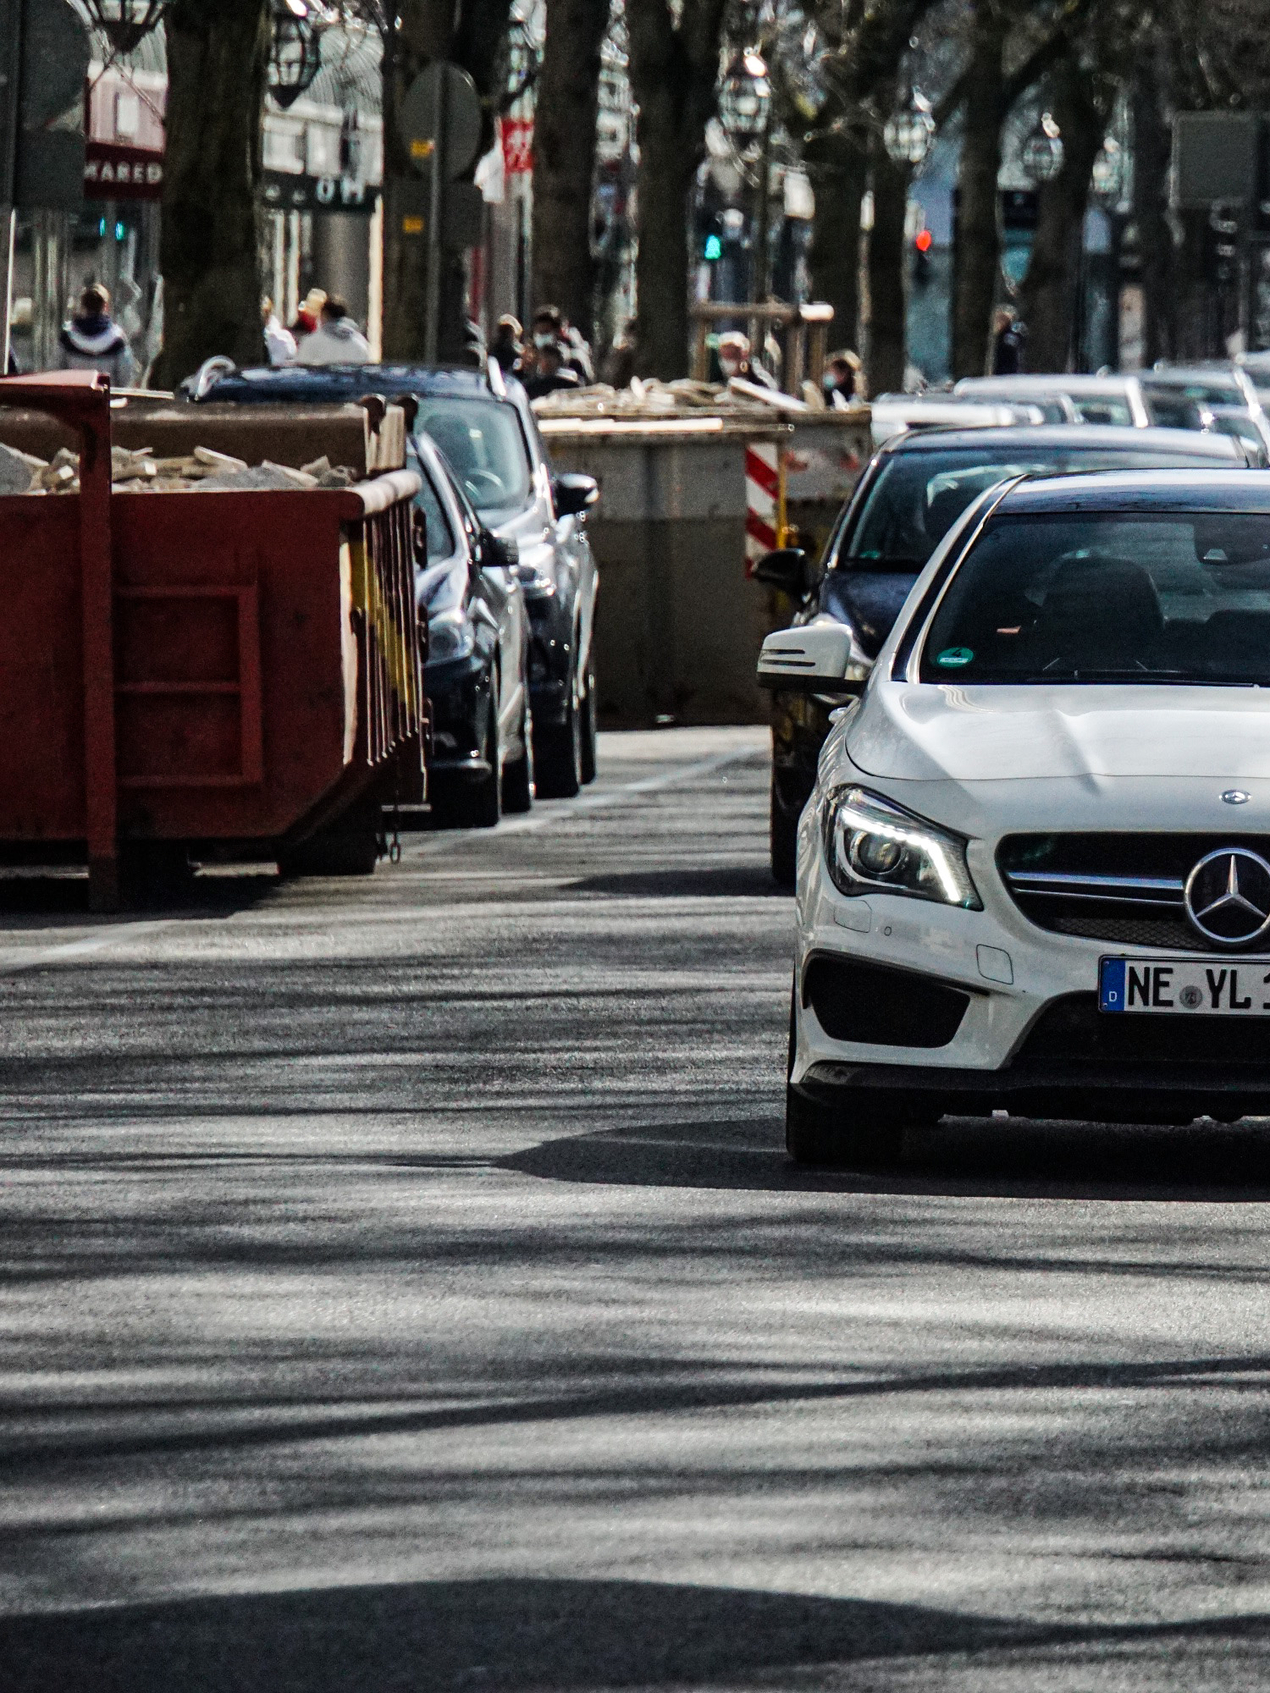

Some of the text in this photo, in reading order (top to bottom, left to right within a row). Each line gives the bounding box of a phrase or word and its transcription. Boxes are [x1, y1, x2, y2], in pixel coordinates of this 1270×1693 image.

[1108, 991, 1118, 1002] D
[1128, 966, 1174, 1007] NE
[1205, 968, 1251, 1009] YL
